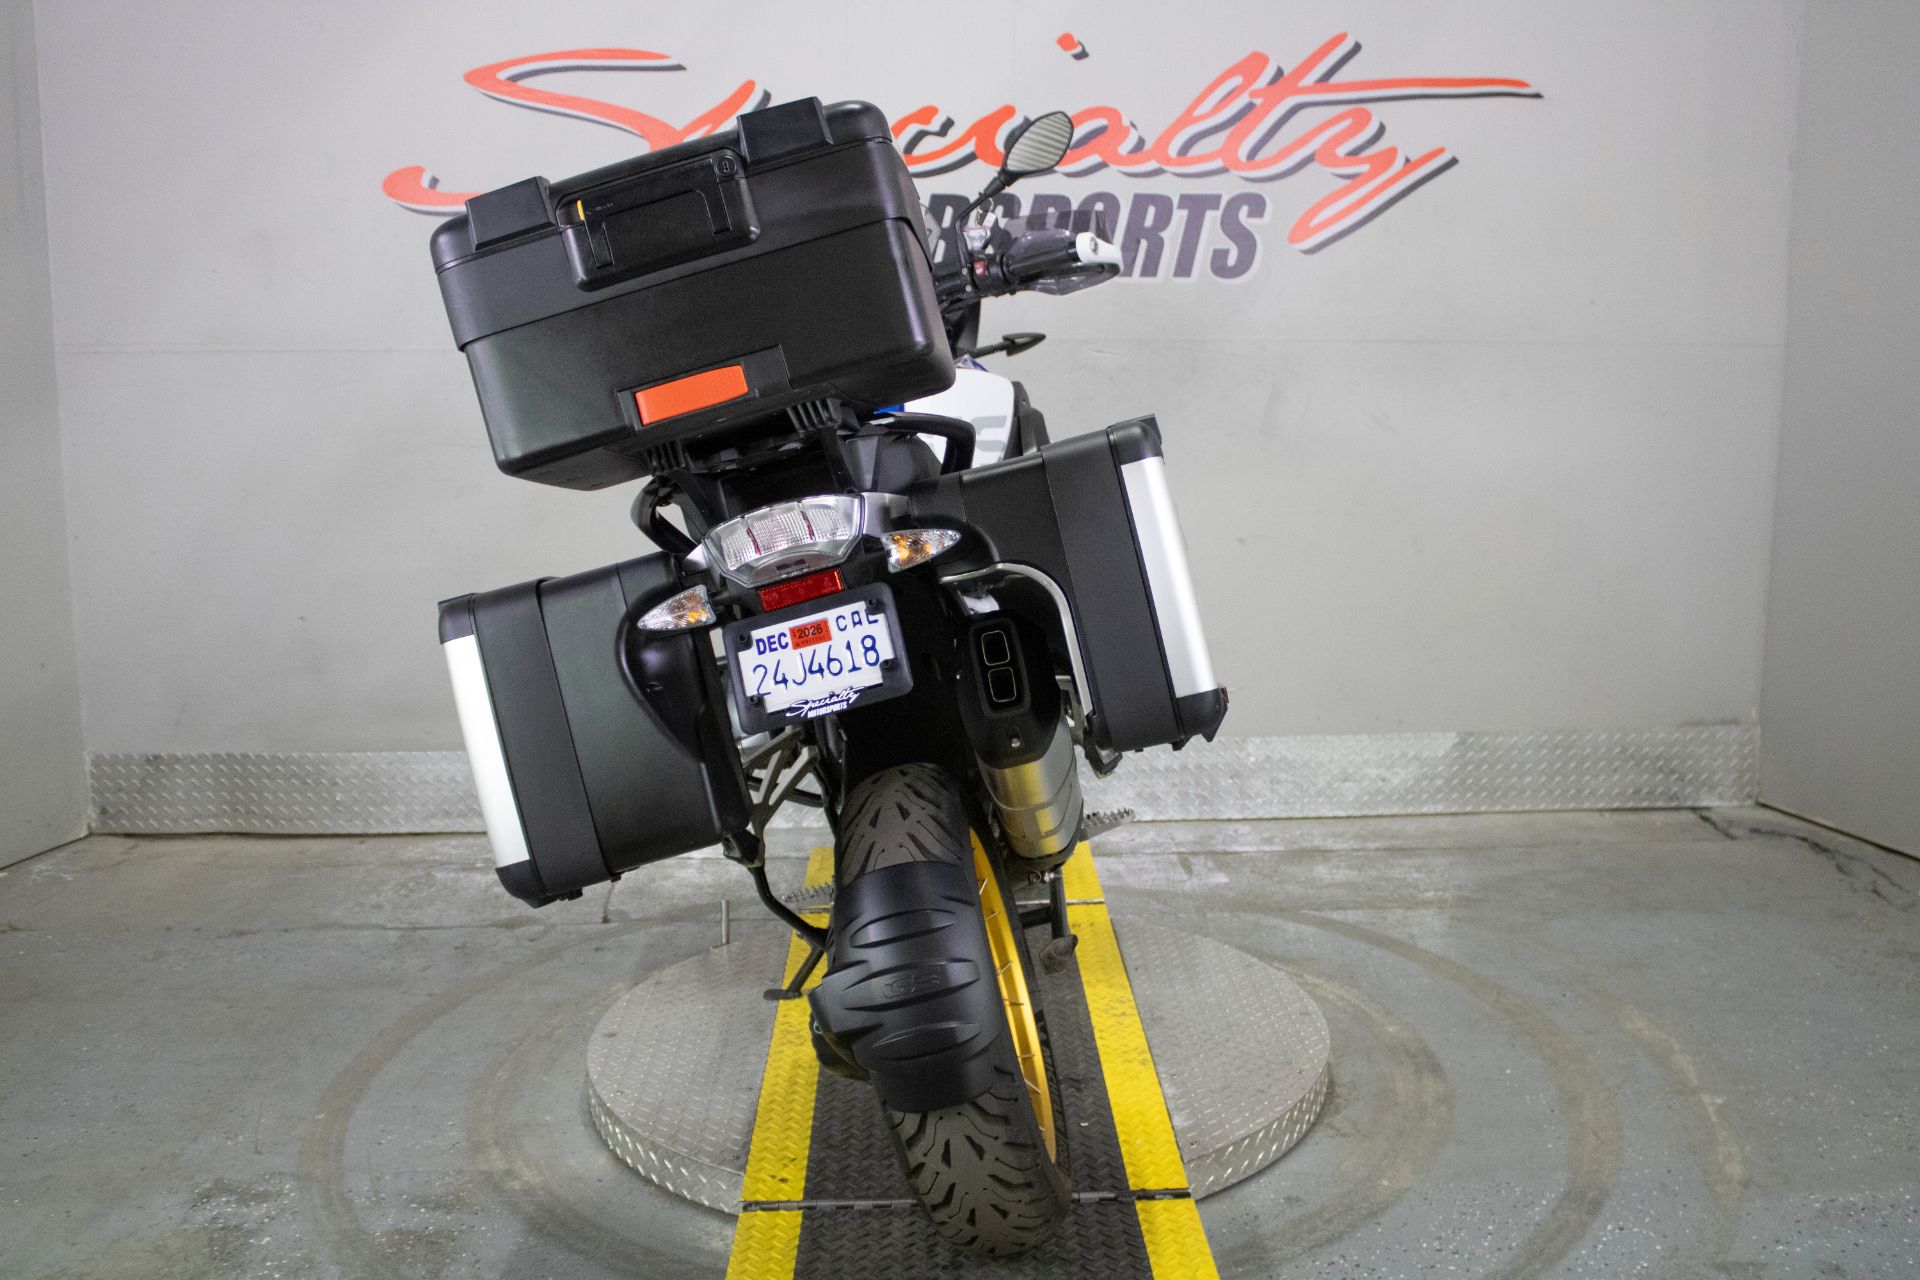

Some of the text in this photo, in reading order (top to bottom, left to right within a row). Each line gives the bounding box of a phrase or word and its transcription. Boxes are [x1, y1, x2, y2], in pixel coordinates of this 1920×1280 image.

[797, 624, 823, 640] 2026
[835, 610, 879, 632] CAL
[755, 632, 789, 655] DEC
[752, 634, 880, 697] 24J4618
[785, 685, 865, 718] Specialty
[807, 701, 848, 719] MOTORSPORTS
